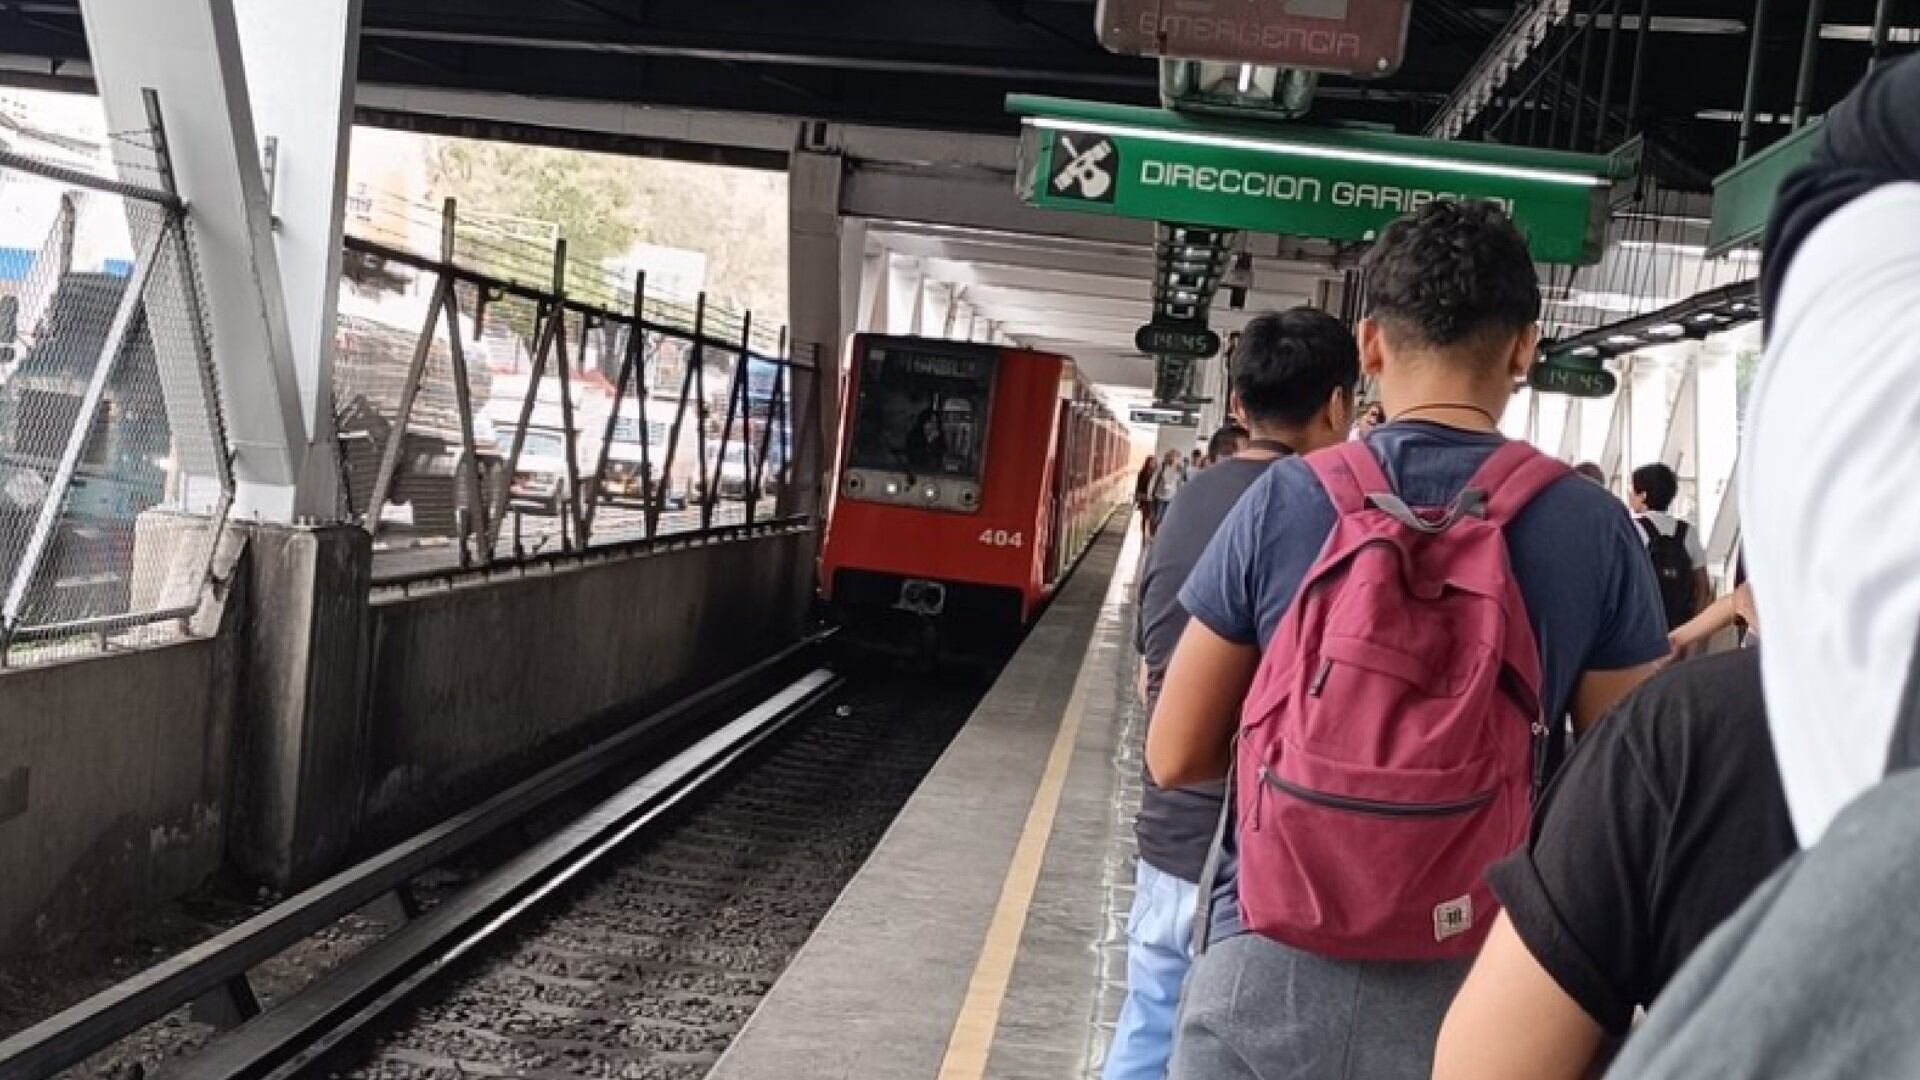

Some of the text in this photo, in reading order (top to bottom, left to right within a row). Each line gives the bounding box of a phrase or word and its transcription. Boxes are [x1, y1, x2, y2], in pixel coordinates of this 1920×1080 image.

[1139, 13, 1360, 57] EMERGENCIA
[1140, 159, 1516, 220] DIRECCION GARIBI
[978, 529, 1022, 548] 404
